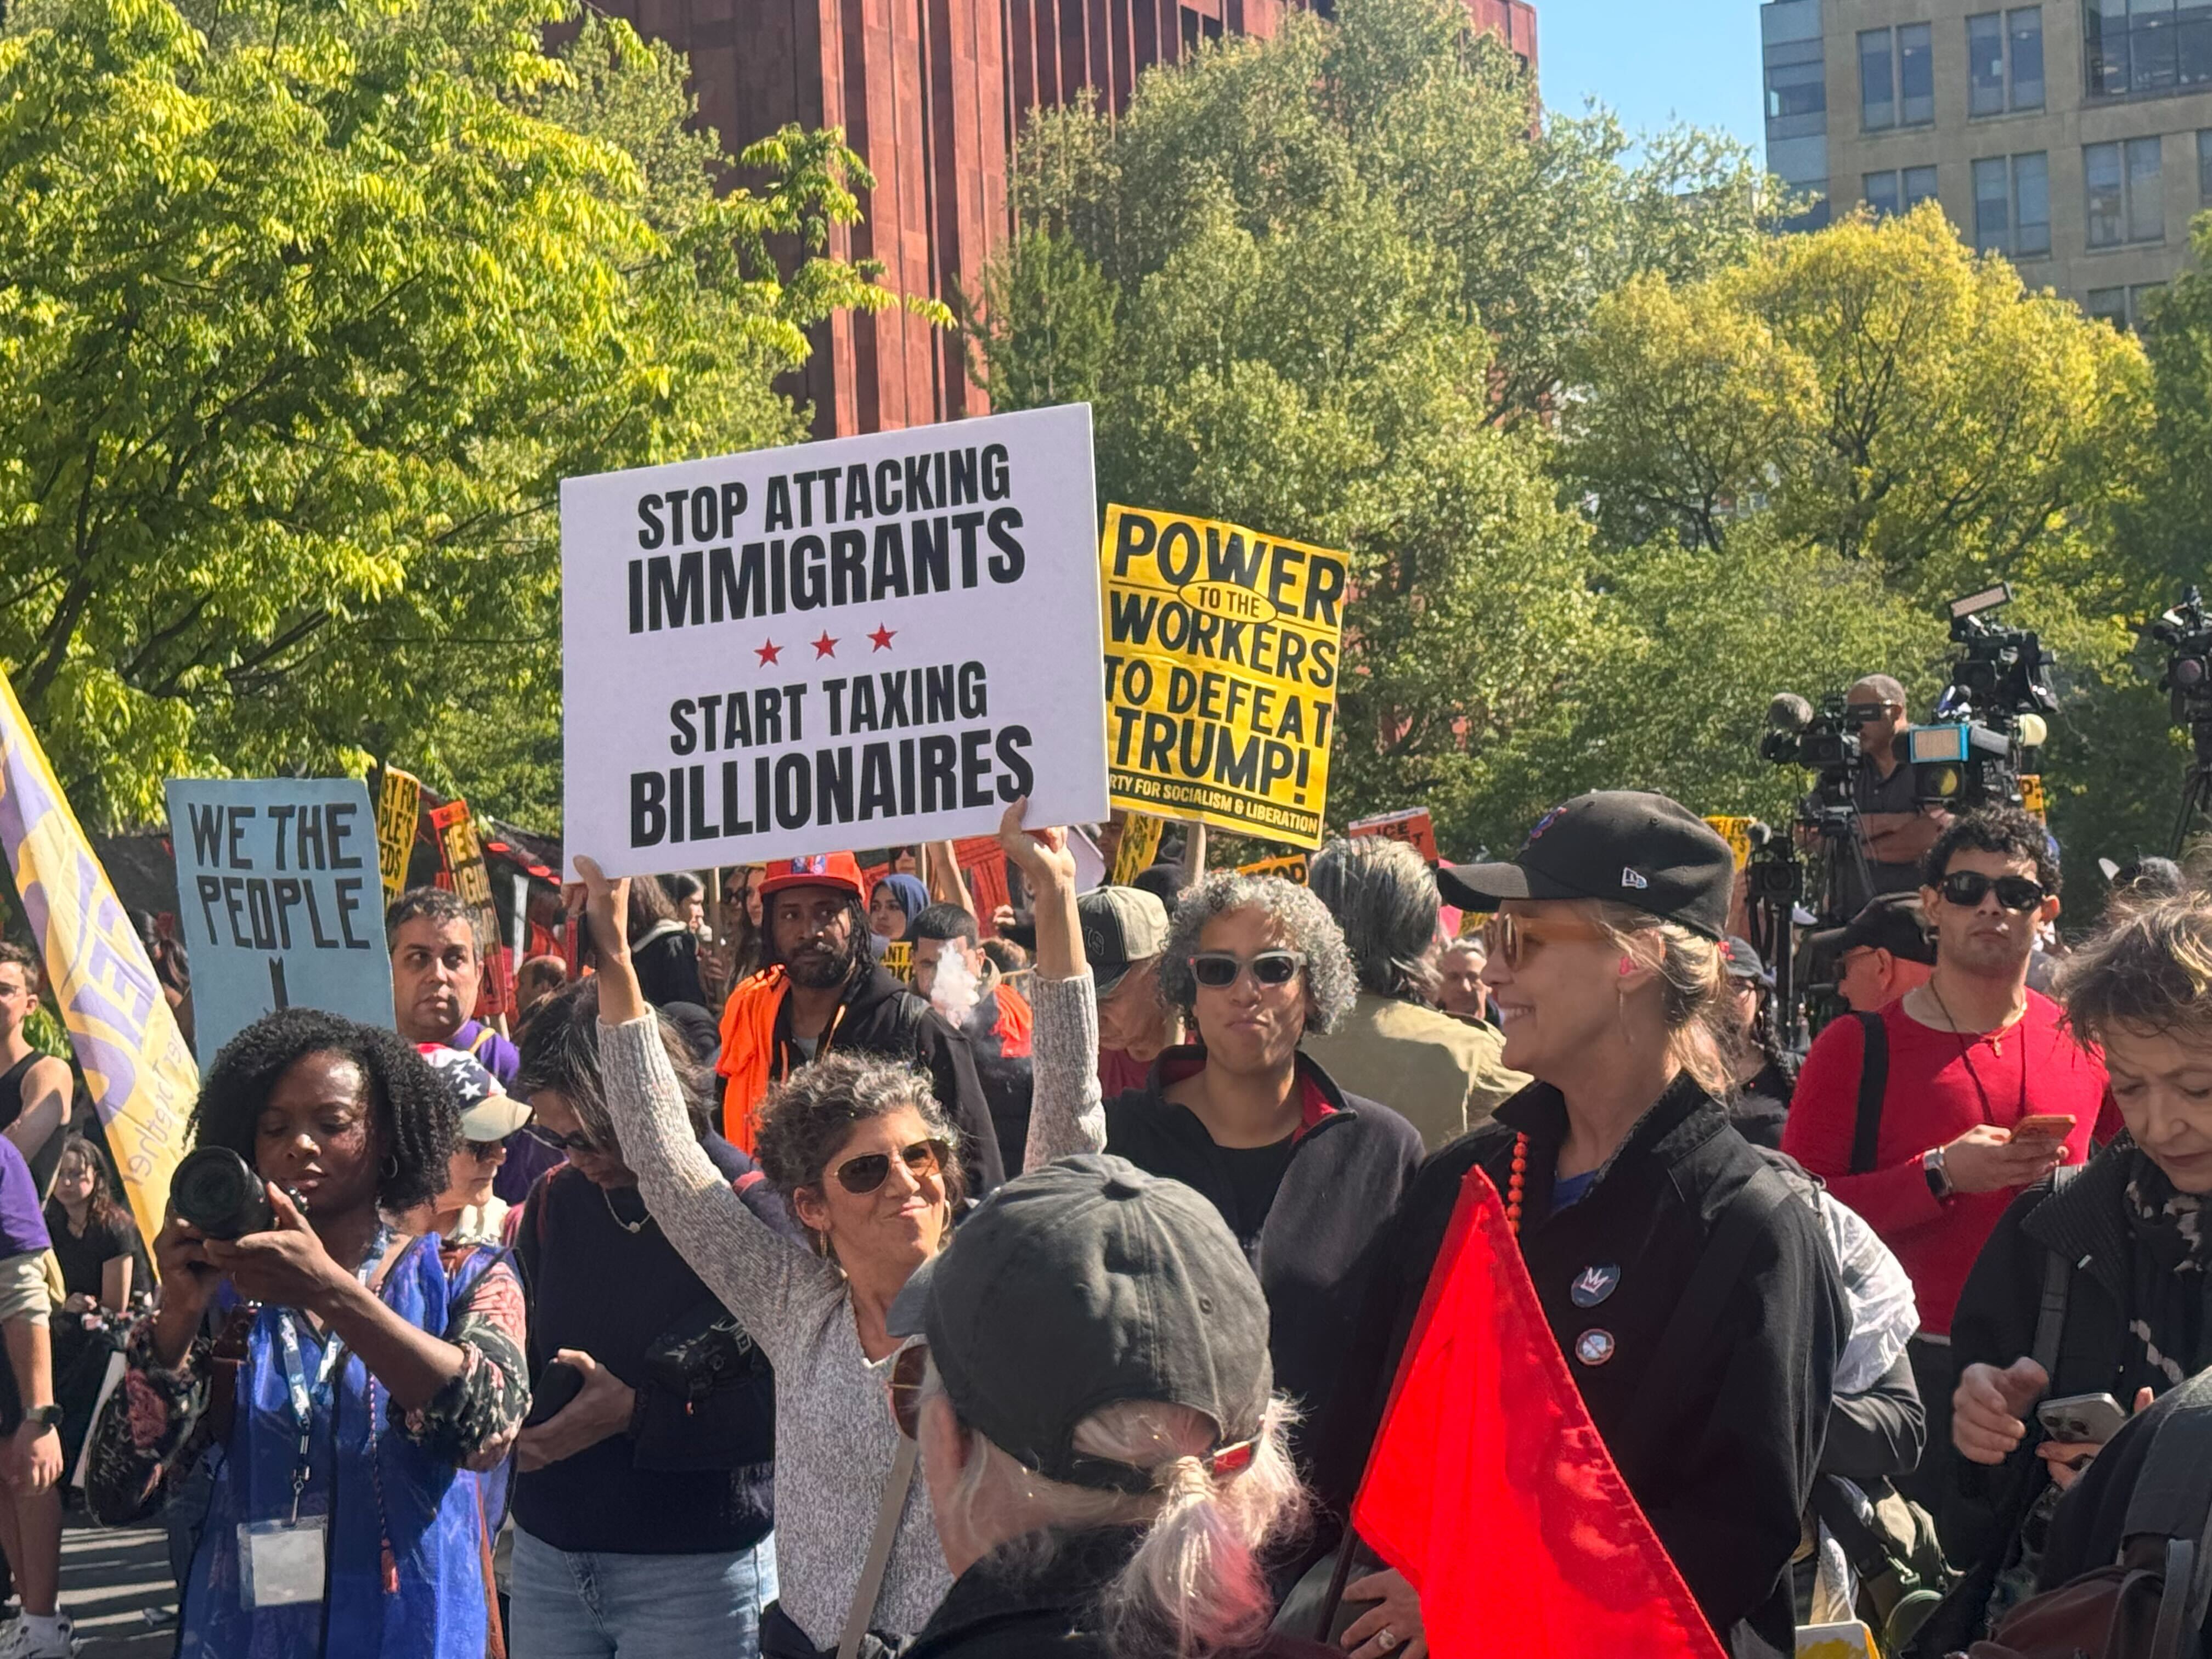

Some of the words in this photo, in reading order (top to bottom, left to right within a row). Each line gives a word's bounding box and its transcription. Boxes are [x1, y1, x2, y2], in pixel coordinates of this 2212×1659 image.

[639, 483, 747, 549] STOP
[765, 443, 1010, 533] ATTACKING
[629, 507, 1025, 634] IMMIGRANTS
[1113, 514, 1346, 627] POWER
[1198, 586, 1220, 609] TO
[1229, 591, 1260, 619] THE
[1111, 591, 1337, 687] WORKERS
[671, 684, 807, 755] START
[823, 661, 987, 736] TAXING
[1104, 655, 1153, 706] TO
[1167, 667, 1333, 748] DEFEAT
[631, 725, 1035, 848] BILLIONAIRES
[1114, 706, 1311, 804] TRUMP!
[188, 803, 256, 870] WE
[268, 803, 363, 871] THE
[1135, 778, 1160, 799] FOR
[1163, 786, 1233, 813] SOCIALISM
[1234, 799, 1245, 814] &
[1246, 802, 1318, 834] LIBERATION
[197, 875, 371, 950] PEOPLE
